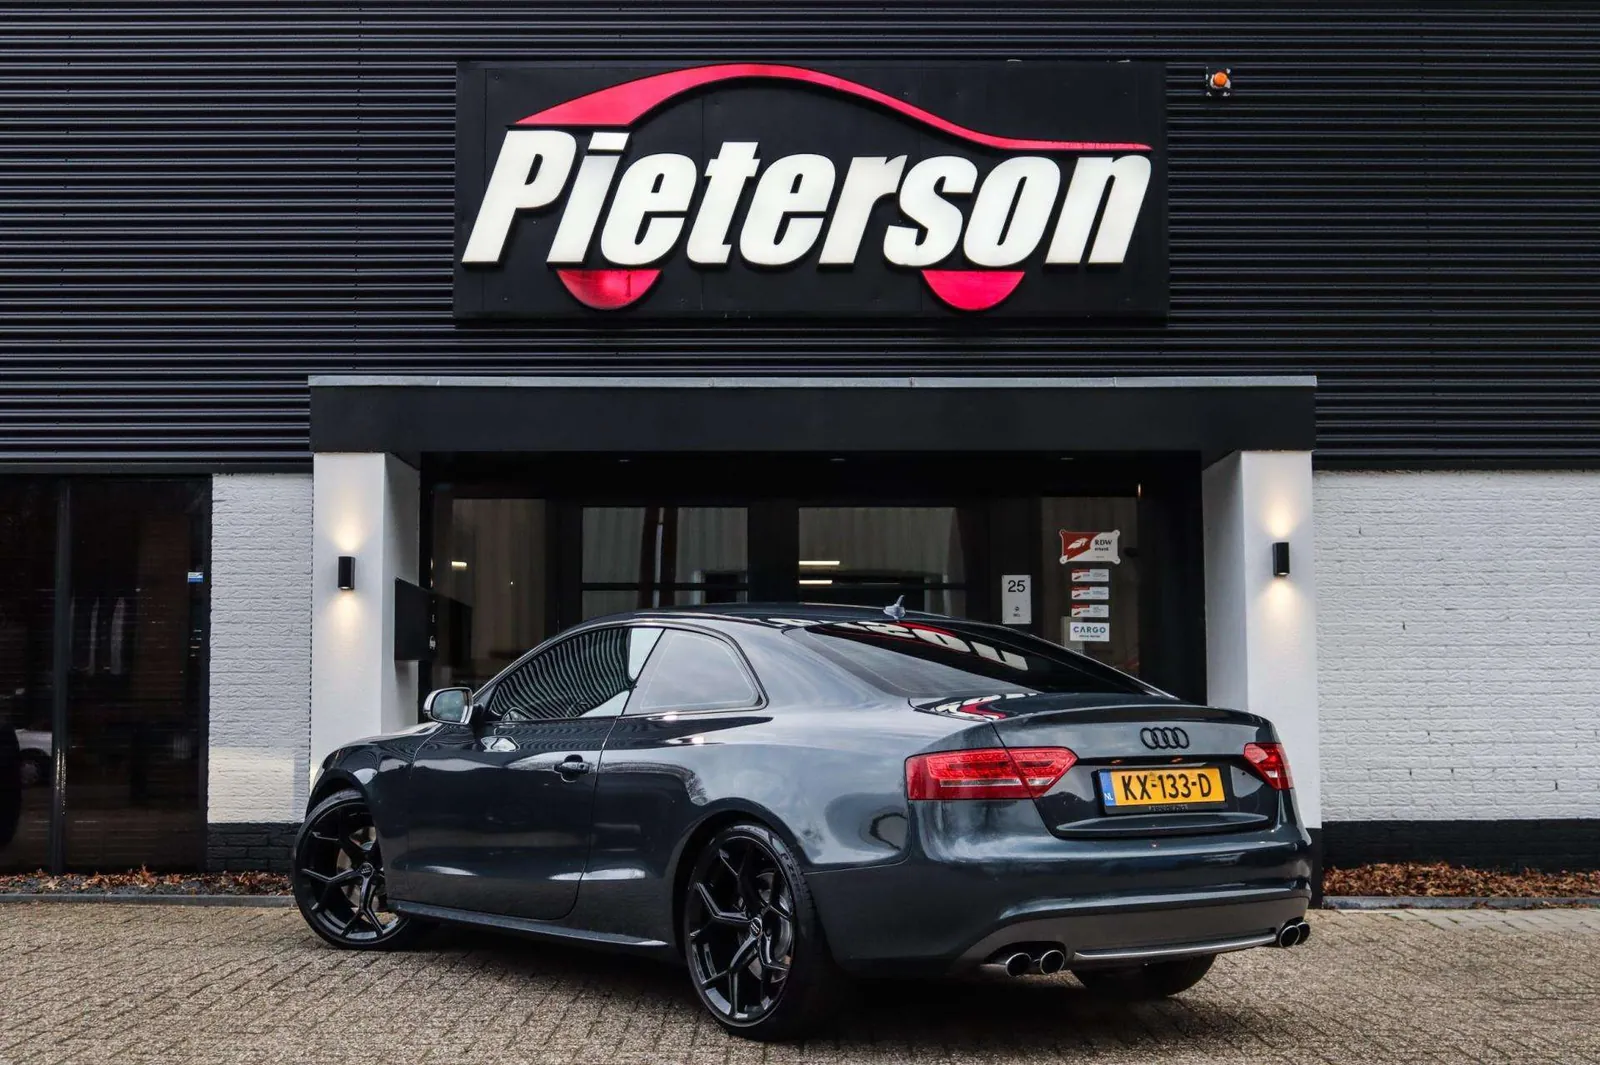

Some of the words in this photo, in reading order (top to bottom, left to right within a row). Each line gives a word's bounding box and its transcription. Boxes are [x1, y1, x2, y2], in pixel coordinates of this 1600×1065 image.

[461, 130, 1152, 267] Pieterson
[1007, 580, 1026, 593] 25
[1073, 626, 1106, 634] CARGO
[1121, 772, 1212, 801] KX-133-D
[1104, 792, 1114, 801] NL
